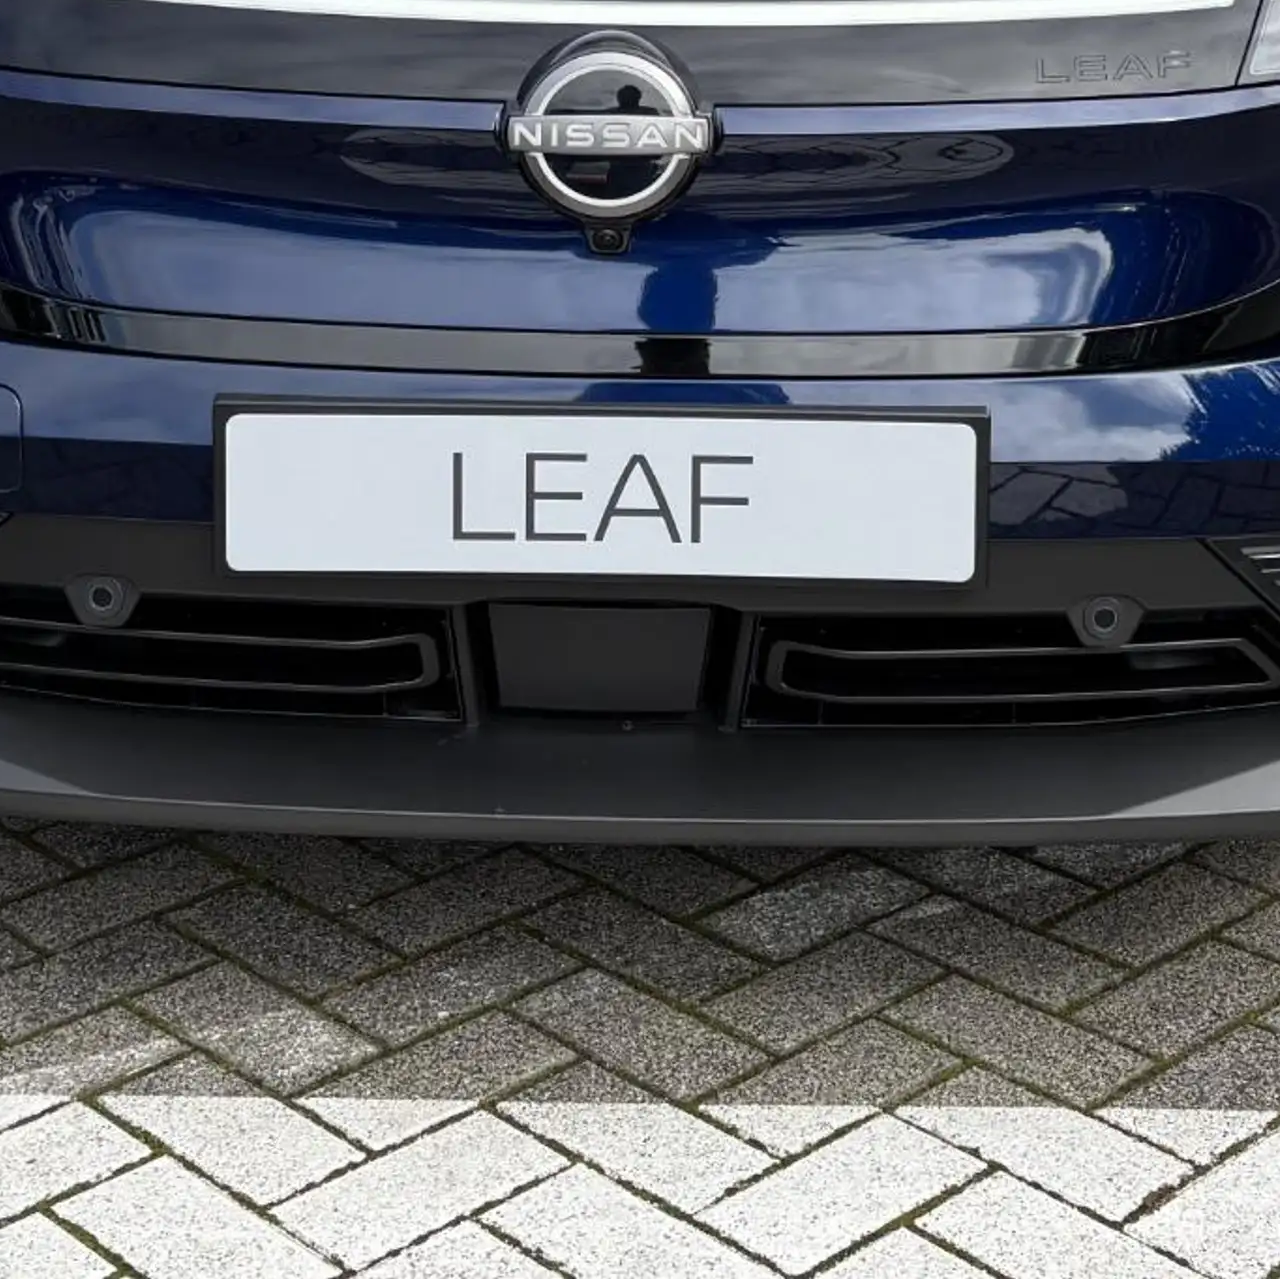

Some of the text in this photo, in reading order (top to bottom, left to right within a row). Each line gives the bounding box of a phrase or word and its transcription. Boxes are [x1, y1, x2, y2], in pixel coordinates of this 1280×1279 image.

[1035, 50, 1191, 84] LEAF
[513, 122, 704, 150] NISSAN
[452, 452, 754, 544] LEAF
